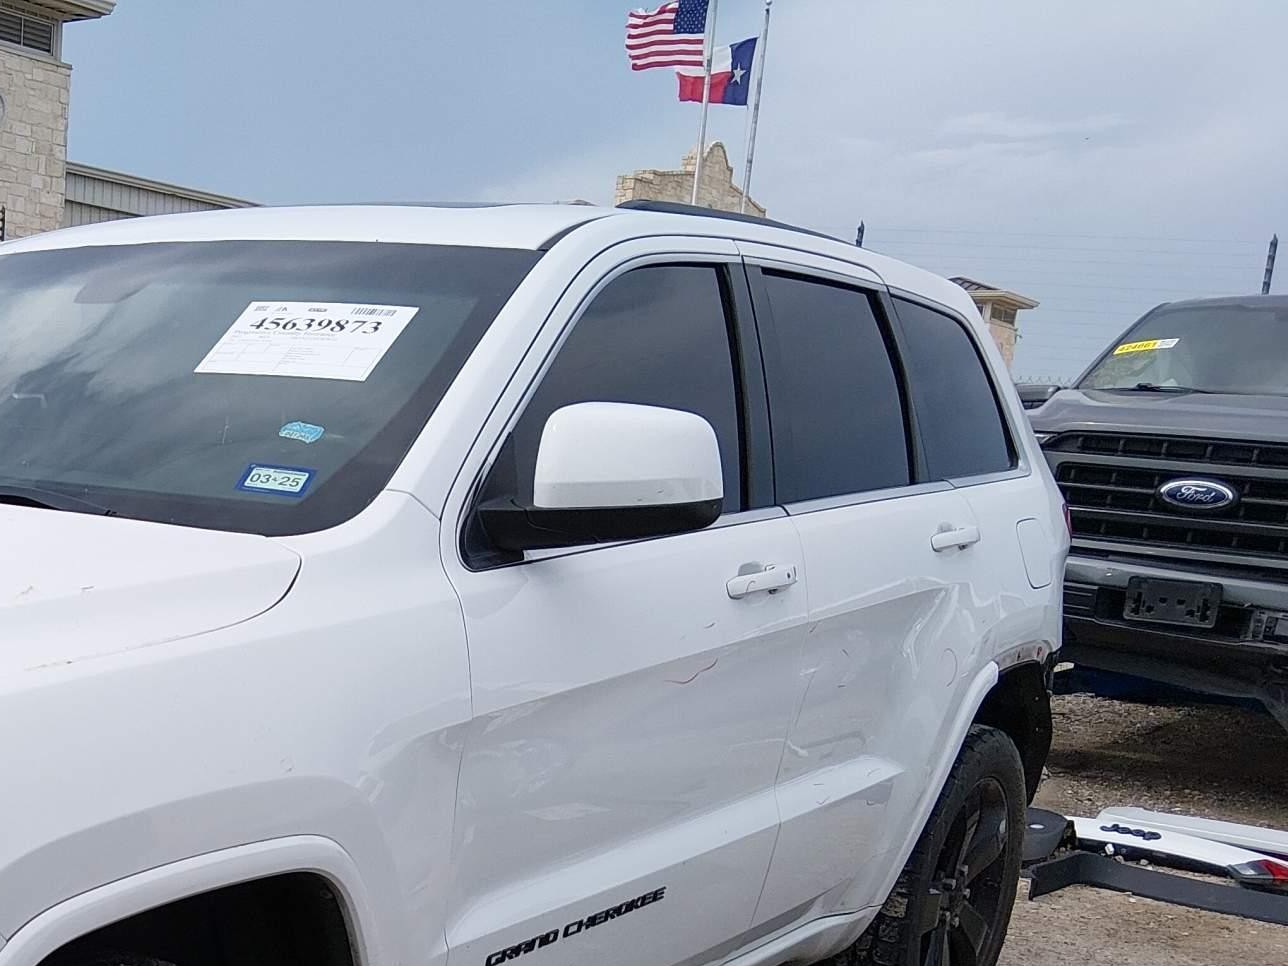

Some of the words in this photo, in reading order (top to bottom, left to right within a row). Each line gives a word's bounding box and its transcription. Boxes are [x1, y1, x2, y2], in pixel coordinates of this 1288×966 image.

[250, 317, 383, 335] 45639873
[1176, 485, 1216, 503] Ford
[1100, 823, 1162, 841] Jeep
[562, 886, 667, 939] CHEROKEE
